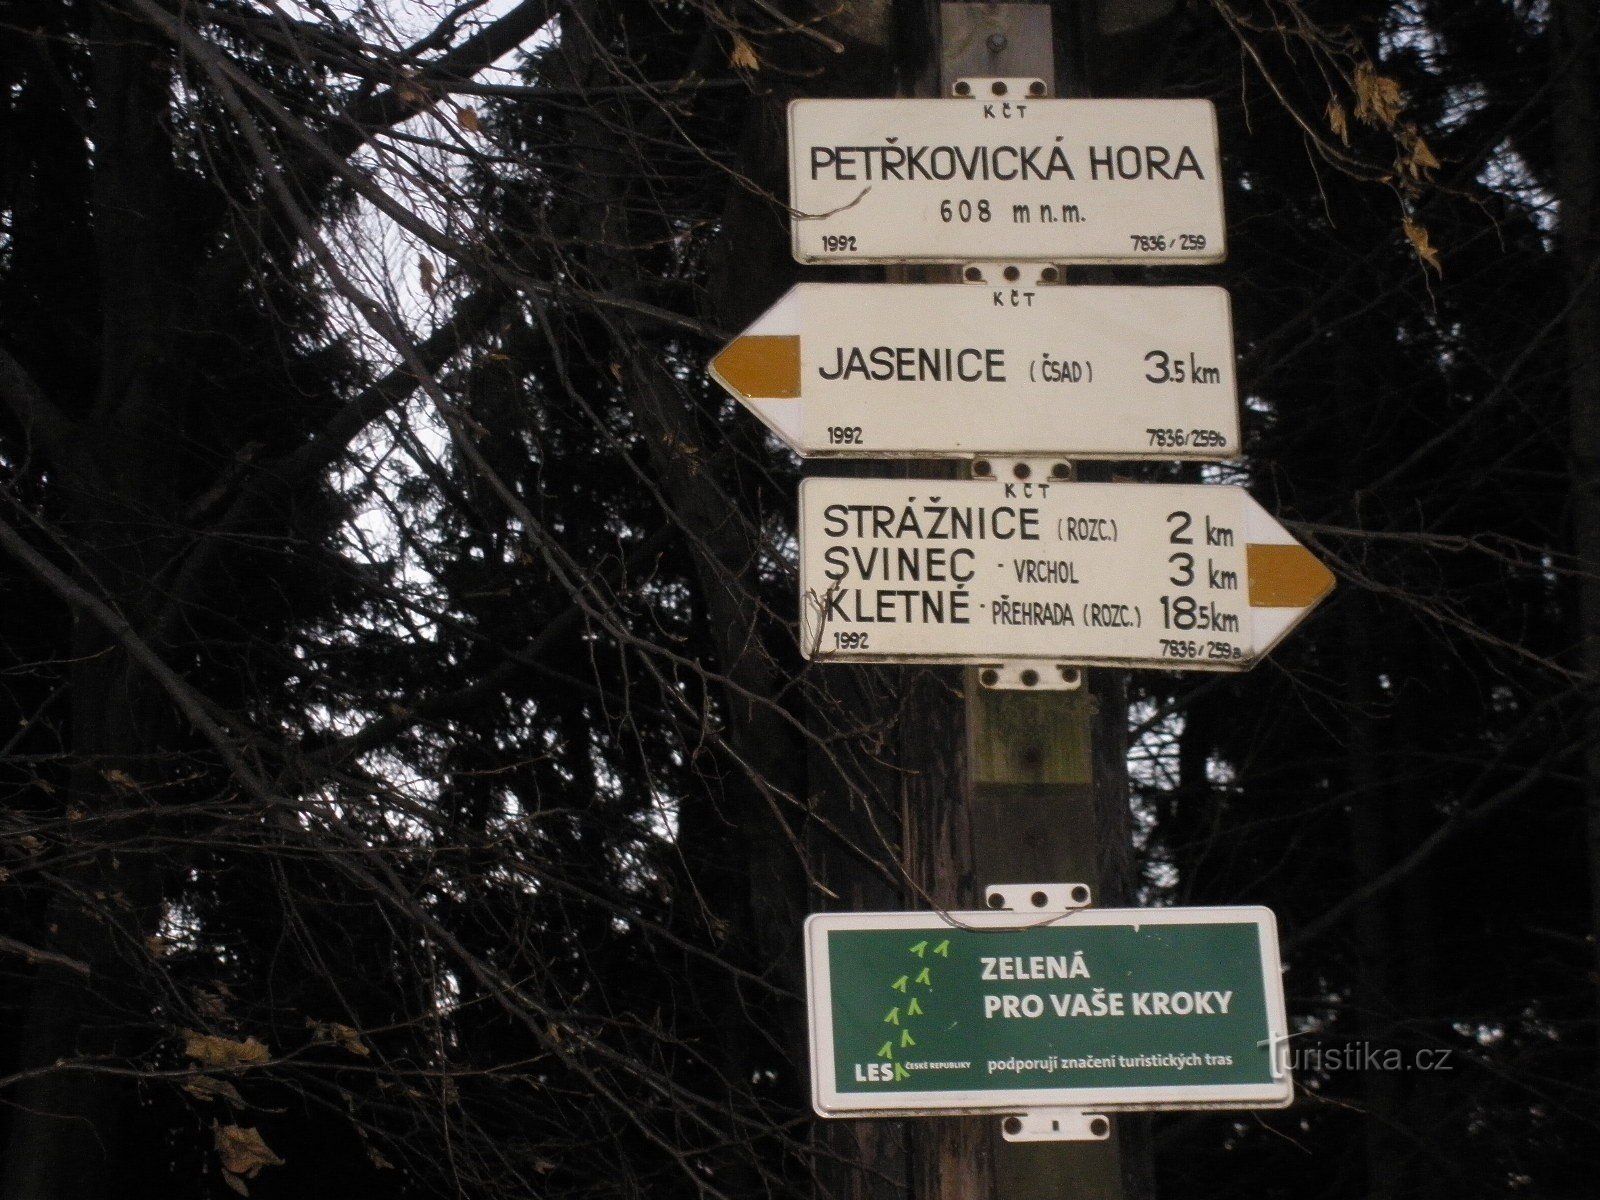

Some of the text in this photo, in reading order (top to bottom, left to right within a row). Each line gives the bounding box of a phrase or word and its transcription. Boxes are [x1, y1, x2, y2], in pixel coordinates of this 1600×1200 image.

[983, 101, 1027, 120] KČT
[810, 135, 1206, 182] PETŘKOVICKÁ HORA
[940, 198, 992, 223] 608
[821, 234, 858, 253] 1992
[992, 289, 1036, 308] KČT
[818, 345, 1007, 383] JASENICE
[1189, 351, 1221, 384] km
[827, 426, 864, 445] 1992
[1004, 482, 1050, 499] KČT
[823, 495, 1234, 547] STRÁŽNICE (ROZC.) 2 km
[824, 545, 976, 583] SVINEC
[1013, 558, 1080, 585] VRCHOL
[1168, 551, 1195, 588] 3
[1208, 558, 1238, 591] km
[826, 584, 970, 625] KLETNÉ
[991, 594, 1075, 627] PŘEHRADA
[1082, 602, 1142, 629] (ROZC.)
[833, 632, 869, 650] 1992
[980, 950, 1091, 981] ZELENÁ
[984, 987, 1233, 1019] PRO VAŠE KROKY
[905, 1061, 971, 1070] ČESKÉ REPUBLIKY
[987, 1052, 1233, 1075] podporují značení turistických tras
